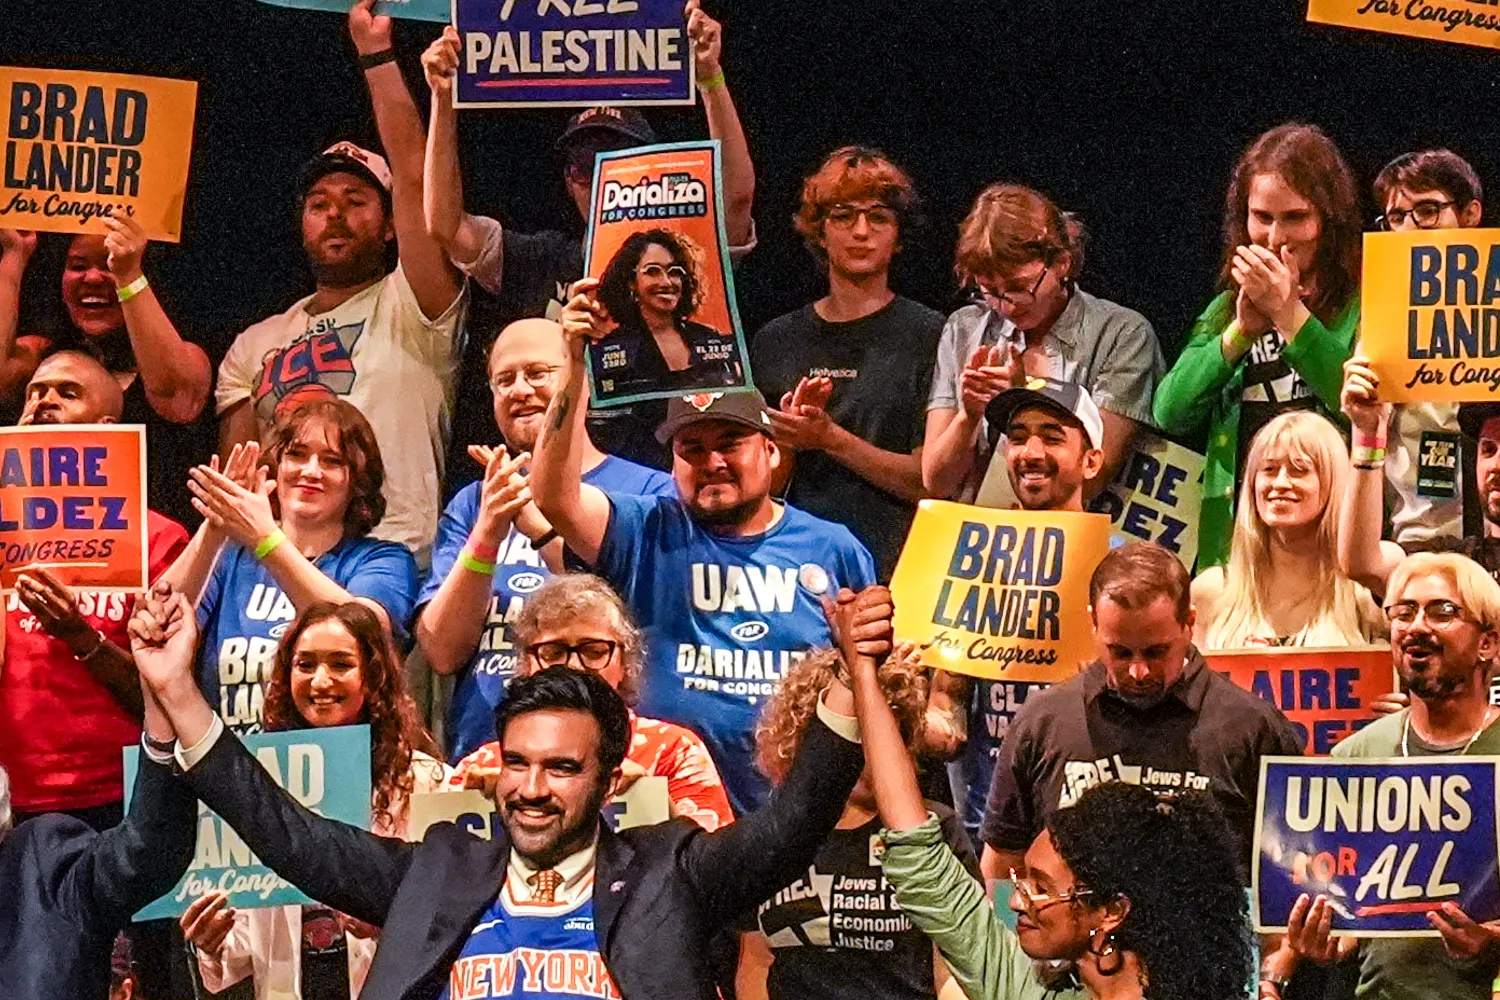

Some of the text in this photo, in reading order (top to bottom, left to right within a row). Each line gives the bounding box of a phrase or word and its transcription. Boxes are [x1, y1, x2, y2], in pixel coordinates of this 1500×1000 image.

[466, 28, 682, 74] PALESTINE
[8, 81, 148, 146] BRAD
[4, 140, 143, 197] LANDER
[0, 192, 136, 225] for Congres
[603, 172, 705, 211] Darializa
[628, 204, 705, 218] CONGRESS
[1409, 244, 1500, 306] BRA
[1407, 308, 1500, 360] LAND
[256, 329, 355, 399] ICE
[1405, 361, 1500, 392] for Cong
[1088, 490, 1188, 554] DEZ
[497, 530, 547, 567] UA
[947, 521, 1066, 587] BRAD
[515, 576, 537, 588] FOR
[692, 562, 799, 613] UAW
[245, 583, 297, 622] UA
[931, 579, 1061, 641] LANDER
[738, 625, 760, 638] FOR
[219, 636, 279, 685] BR
[677, 643, 808, 682] DARIALI
[967, 637, 1058, 671] Congress
[684, 676, 783, 697] FOR CONG
[1251, 667, 1361, 711] AIRE
[256, 743, 325, 806] AD
[1142, 767, 1210, 790] Jews For
[1285, 774, 1472, 833] UNIONS
[175, 872, 216, 902] for
[834, 875, 877, 891] Jews
[1355, 840, 1461, 903] ALL
[833, 893, 886, 911] Racial
[835, 932, 894, 951] Justice
